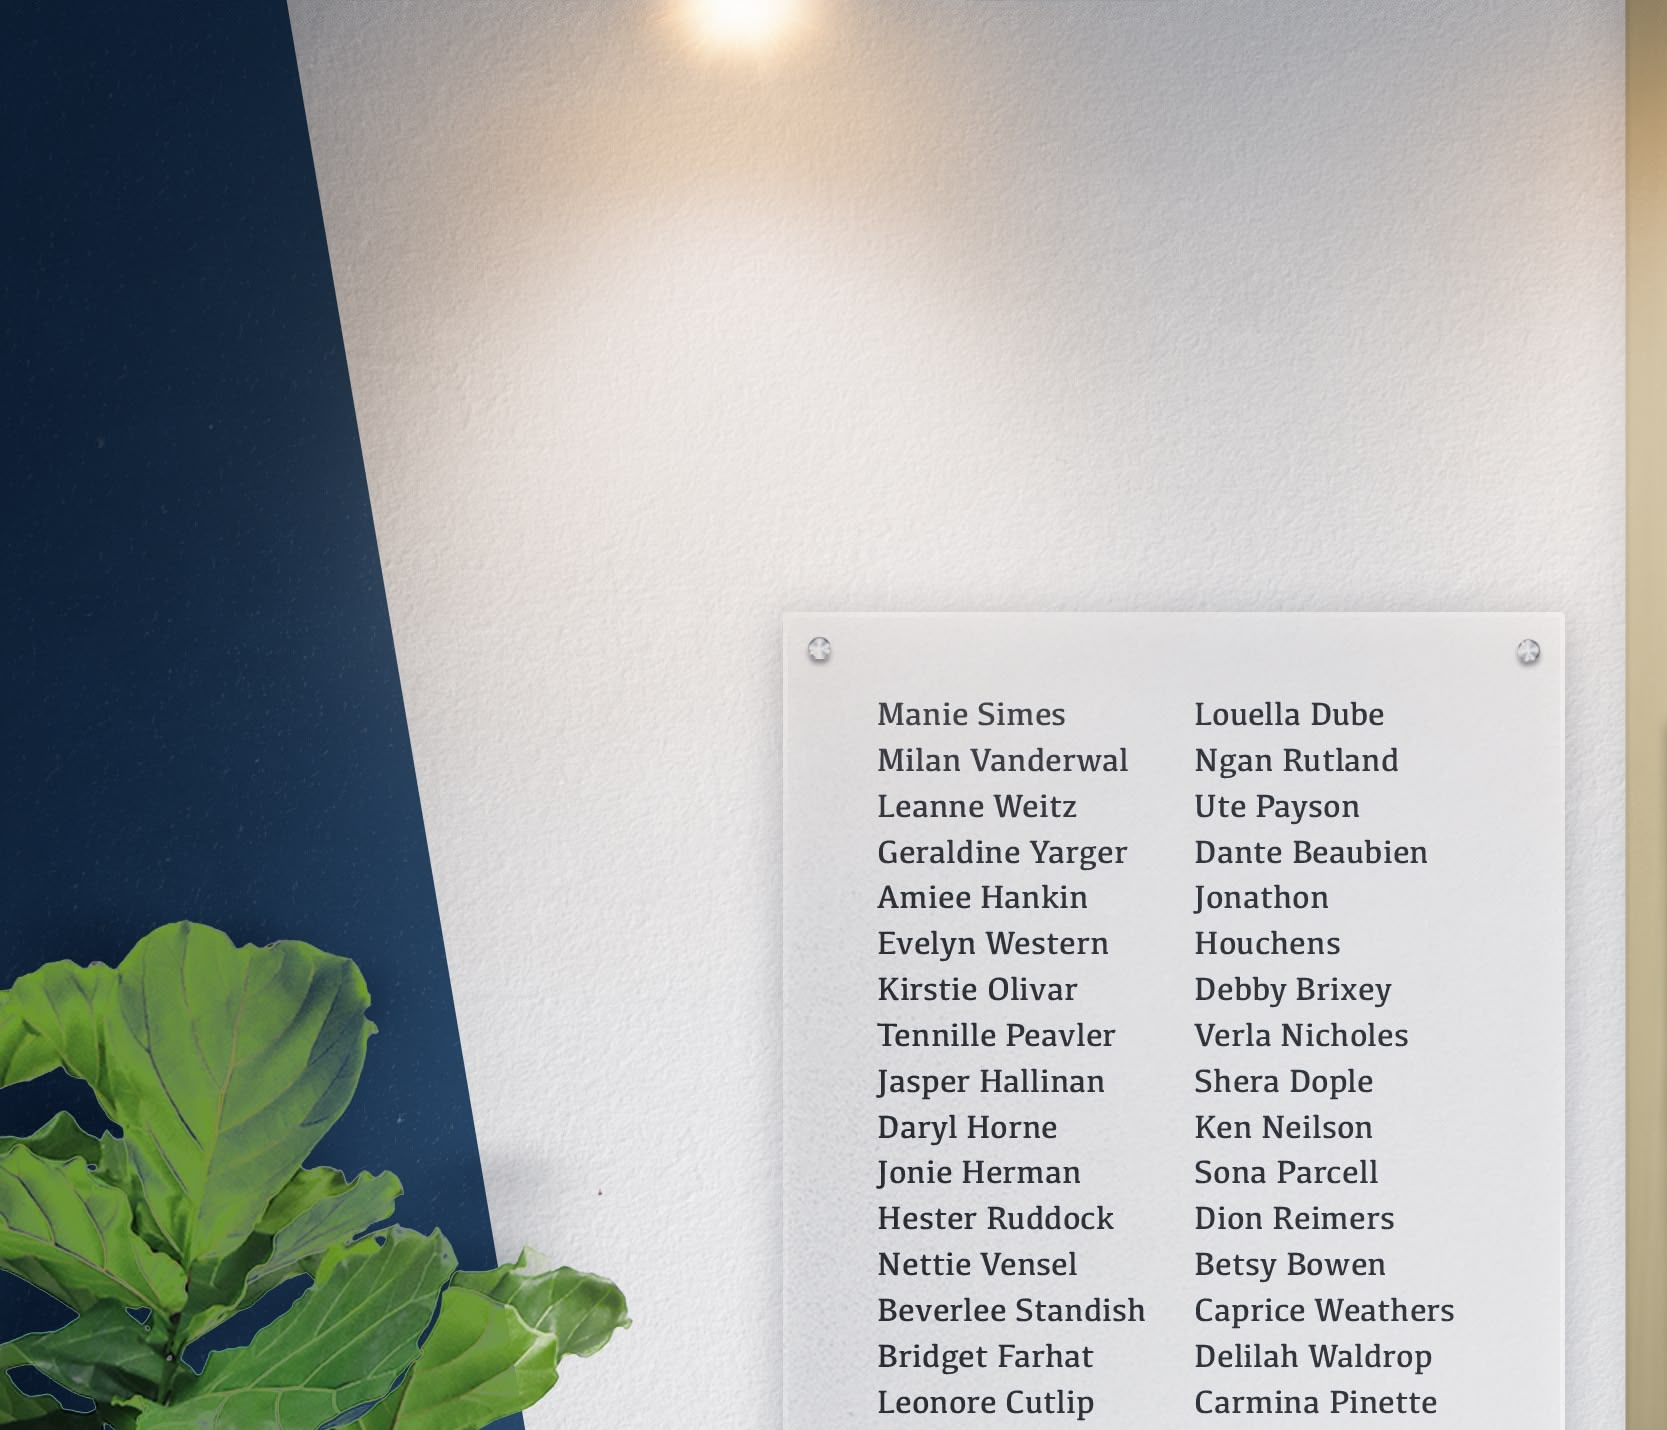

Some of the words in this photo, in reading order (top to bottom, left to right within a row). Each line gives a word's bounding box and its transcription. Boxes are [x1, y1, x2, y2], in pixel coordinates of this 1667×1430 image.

[877, 701, 969, 727] Manie
[977, 701, 1066, 727] Simes
[1194, 747, 1273, 780] Ngan
[1282, 746, 1399, 773] Rutland
[877, 793, 985, 819] Leanne
[992, 793, 1078, 819] Weitz
[1194, 839, 1282, 865] Dante
[1292, 838, 1428, 865] Beaubien
[876, 884, 971, 910] Amiee
[980, 883, 1088, 910] Hankin
[1194, 929, 1341, 956] Houchens
[877, 976, 977, 1002] Kirstie
[988, 975, 1079, 1002] Olivar
[1193, 1021, 1272, 1048] Verla
[1280, 1021, 1409, 1048] Nicholes
[875, 1068, 971, 1101] Jasper
[979, 1067, 1105, 1094] Hallinan
[1194, 1114, 1252, 1140] Ken
[1261, 1113, 1373, 1140] Neilson
[875, 1159, 953, 1190] Jonie
[961, 1159, 1081, 1185] Herman
[1194, 1205, 1263, 1231] Dion
[1272, 1205, 1395, 1231] Reimers
[877, 1251, 972, 1277] Nettie
[979, 1250, 1078, 1277] Vensel
[1195, 1297, 1305, 1330] Caprice
[1313, 1296, 1455, 1323] Weathers
[877, 1342, 989, 1376] Bridget
[997, 1342, 1095, 1369] Farhat
[1195, 1389, 1320, 1415] Carmina
[1329, 1389, 1438, 1415] Pinette
